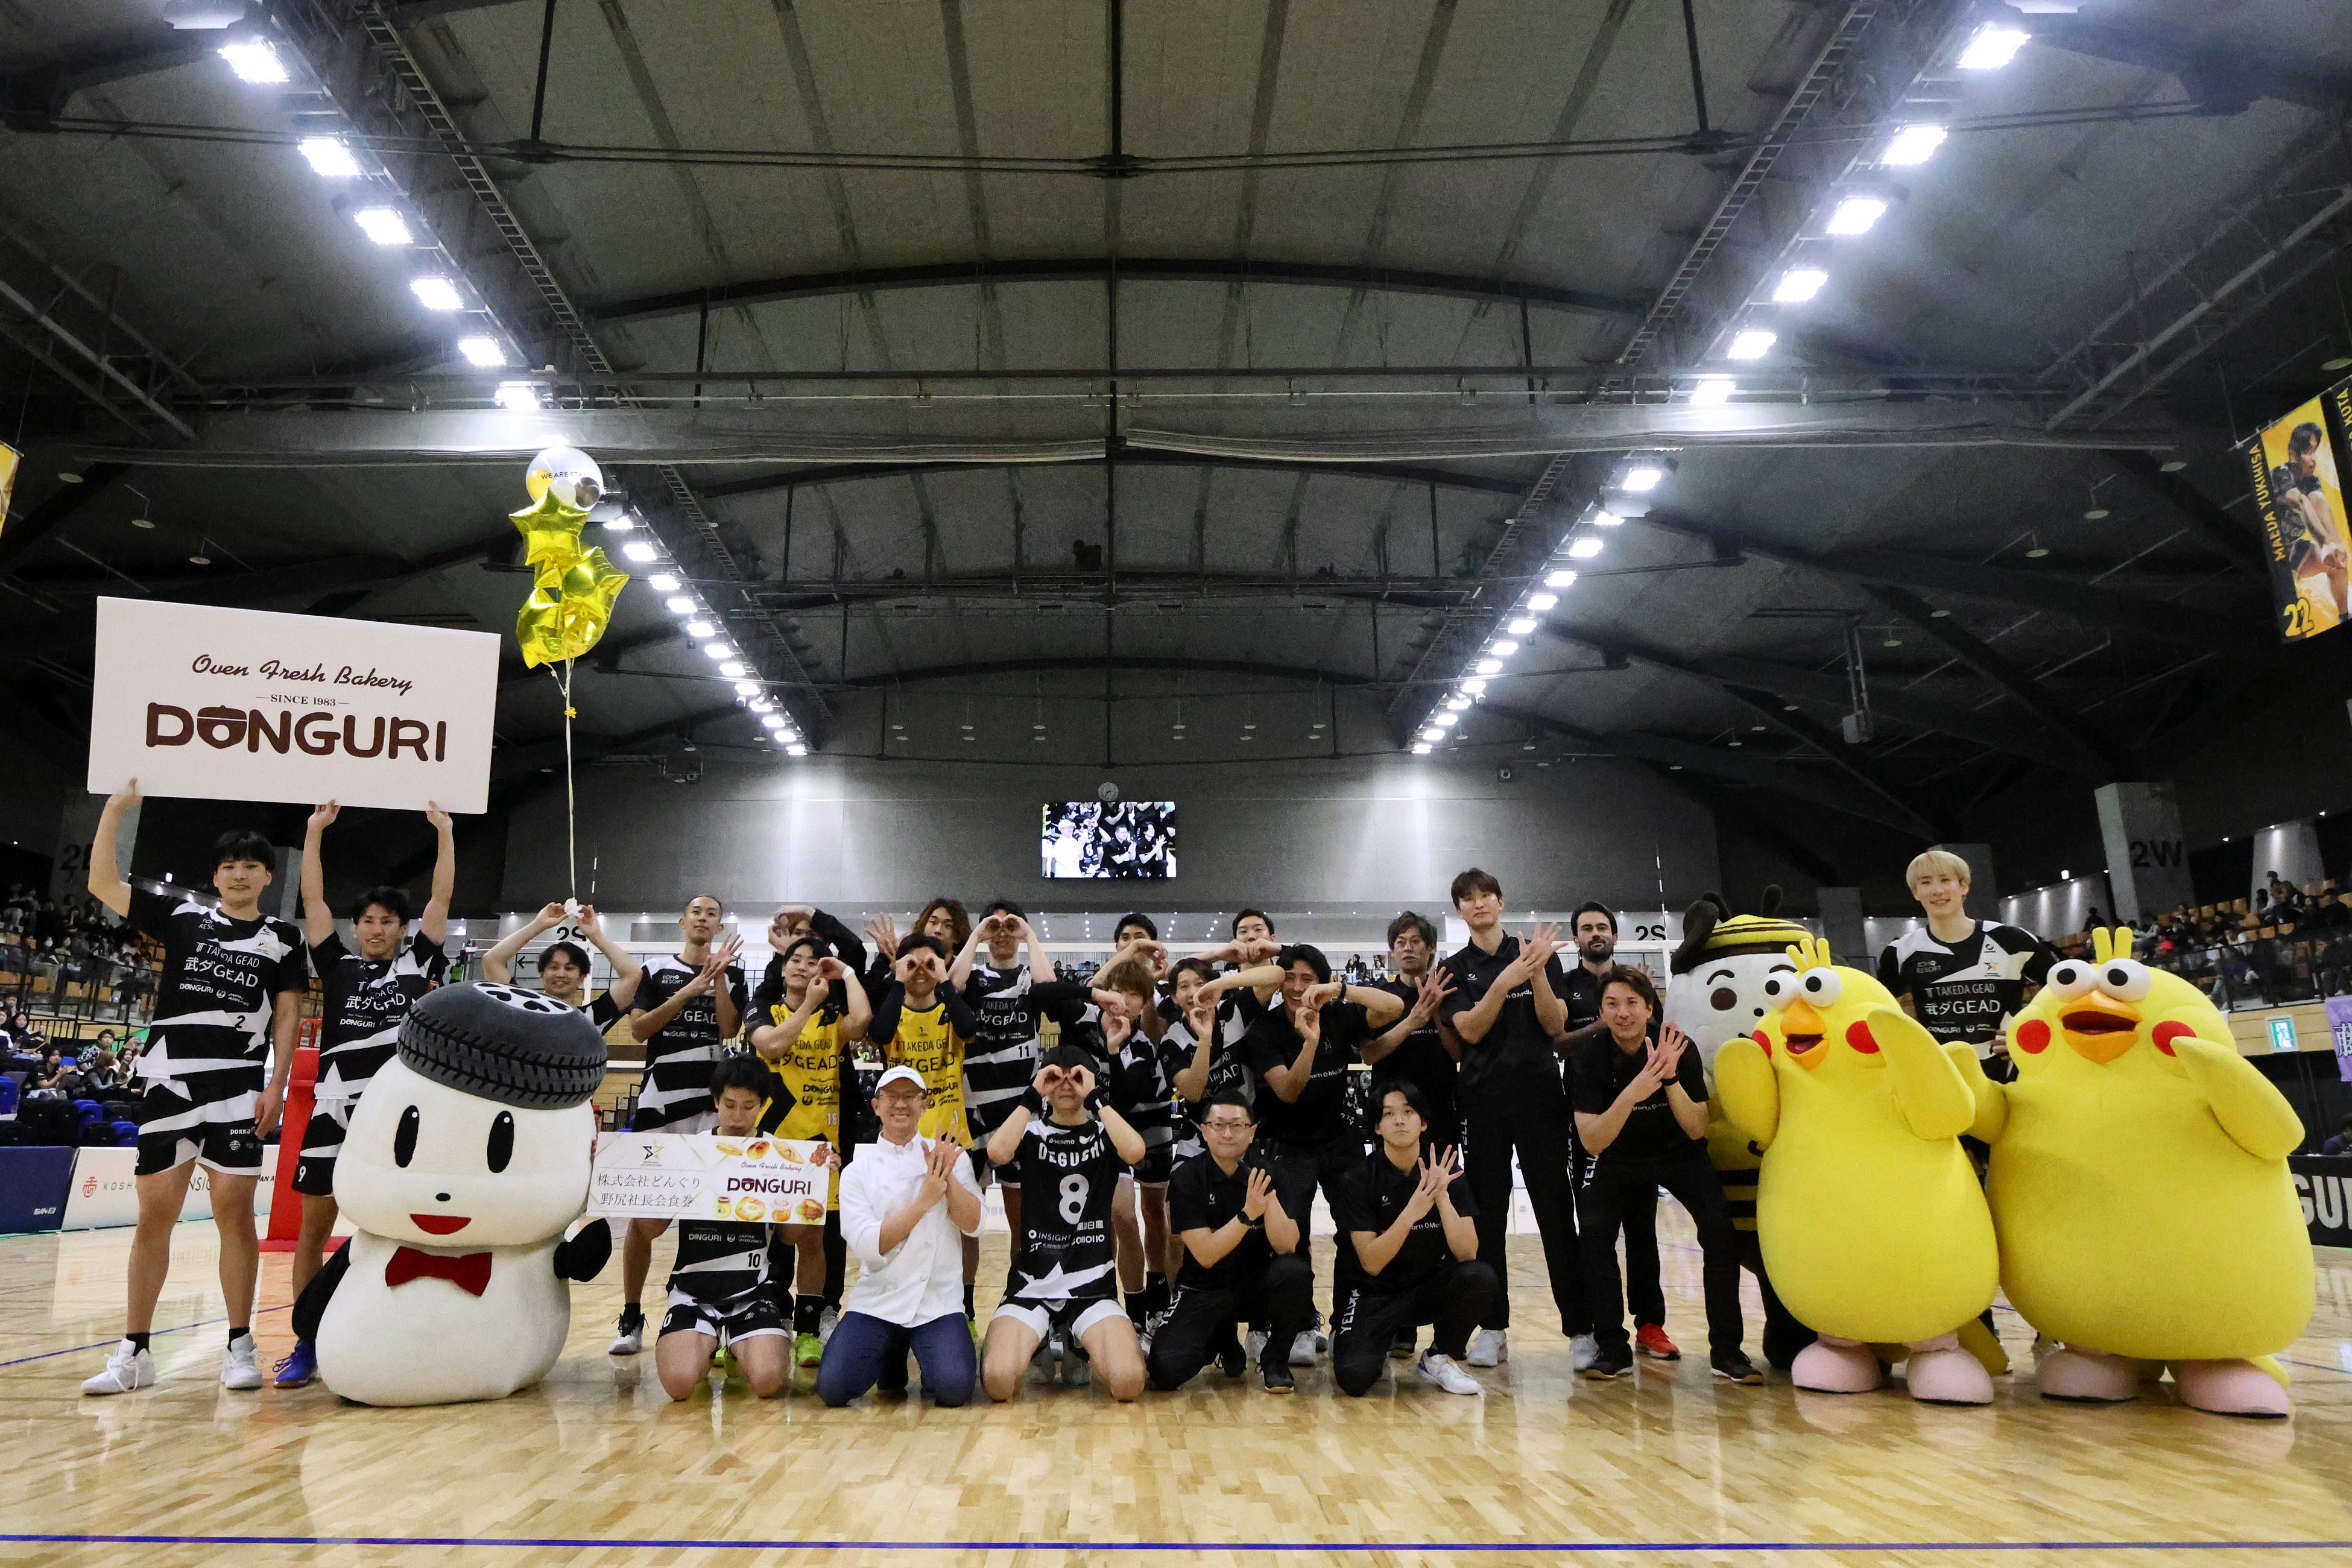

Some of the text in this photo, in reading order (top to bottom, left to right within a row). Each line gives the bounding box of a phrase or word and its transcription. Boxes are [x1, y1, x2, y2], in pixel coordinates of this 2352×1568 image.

[2249, 443, 2286, 561] MAEDA YUKIHISA
[2283, 597, 2315, 637] 22
[192, 654, 413, 697] Oven Fresh Bakery
[270, 694, 337, 707] SINCE 1983
[145, 702, 447, 762] DONGURI
[2129, 840, 2182, 868] 2W
[1635, 925, 1666, 941] 2S
[235, 955, 260, 968] GEAD
[1935, 983, 1996, 997] TAKEDA GEAD
[235, 1015, 246, 1029] 2
[340, 1019, 375, 1028] DONGURI
[902, 1040, 934, 1052] TAKEDA
[1019, 1045, 1029, 1058] 11
[827, 1113, 838, 1126] 18
[1038, 1137, 1105, 1168] DEGUCHI
[299, 1165, 306, 1183] 9
[596, 1174, 700, 1189] 株式会社どんぐり
[103, 1181, 137, 1190] KOSH
[727, 1177, 811, 1195] DONGURI
[601, 1192, 694, 1208] 野尻社長会食券
[1059, 1174, 1090, 1225] 8
[1038, 1231, 1072, 1242] INSIGHT
[748, 1253, 761, 1268] 10
